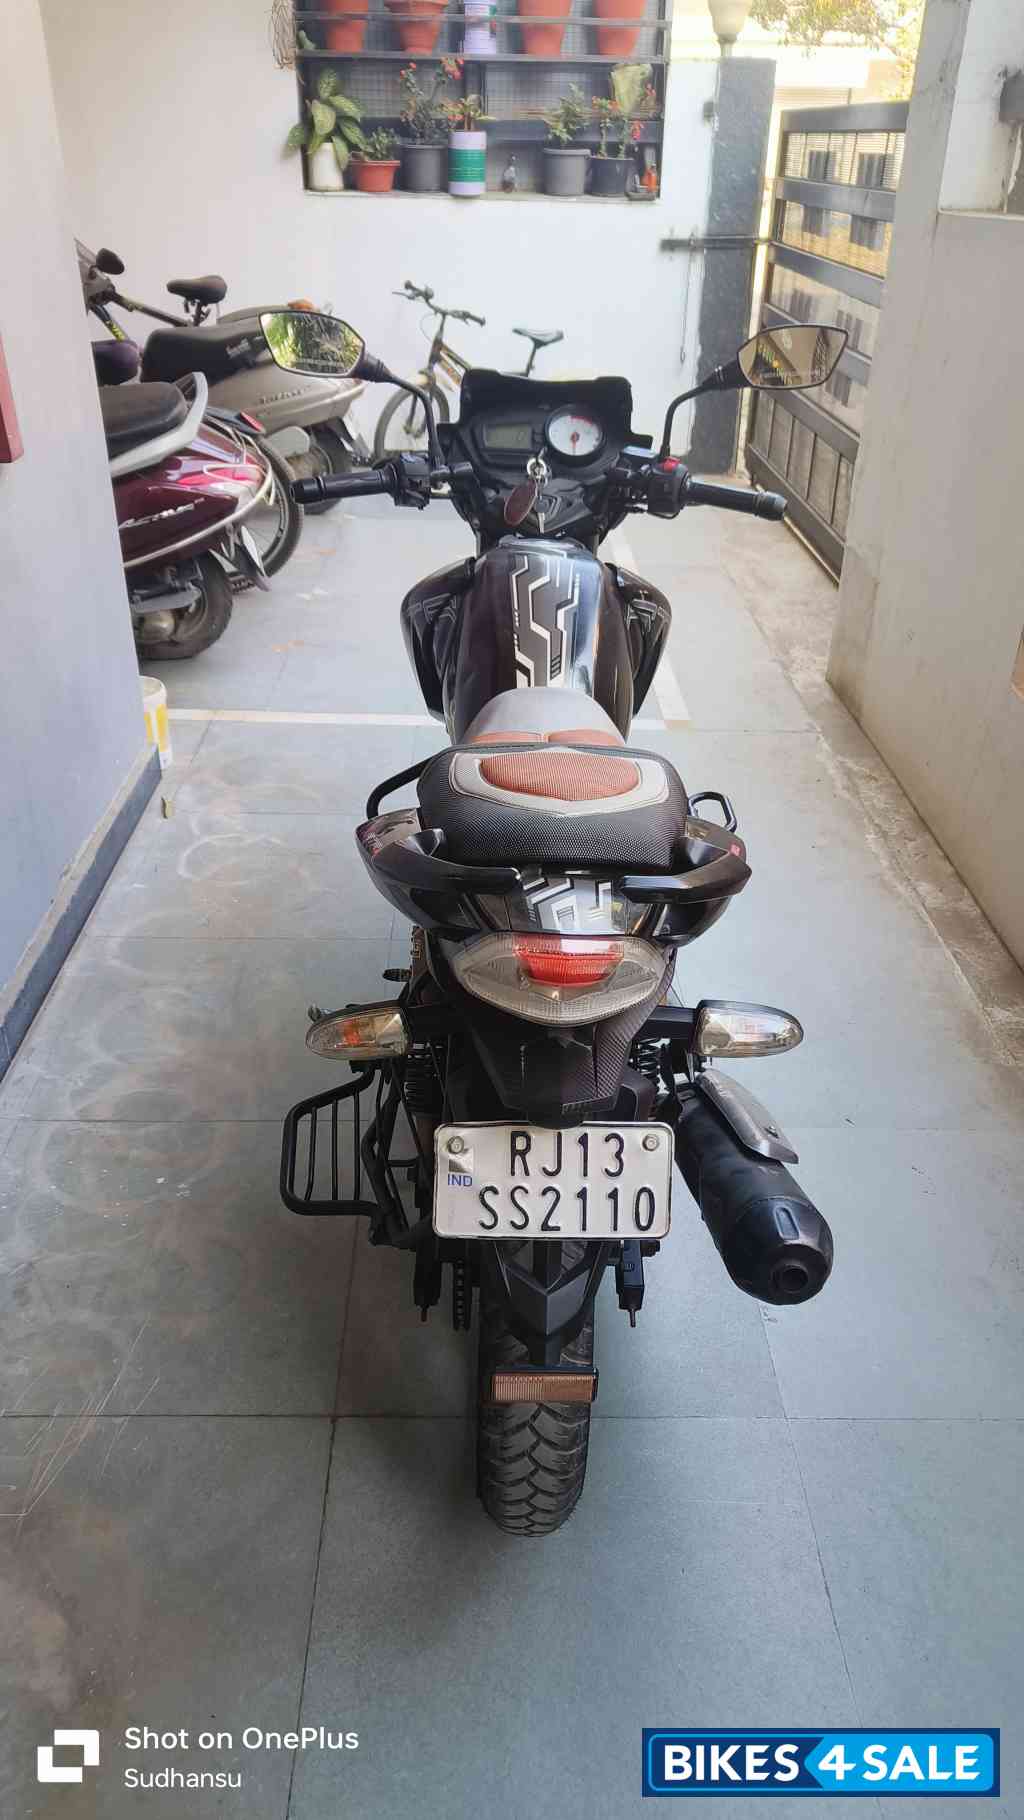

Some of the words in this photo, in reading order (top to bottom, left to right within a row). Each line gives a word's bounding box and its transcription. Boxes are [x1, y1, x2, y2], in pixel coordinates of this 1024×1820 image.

[510, 1131, 625, 1178] RJ13
[448, 1173, 473, 1188] IND
[478, 1185, 656, 1232] SS2110
